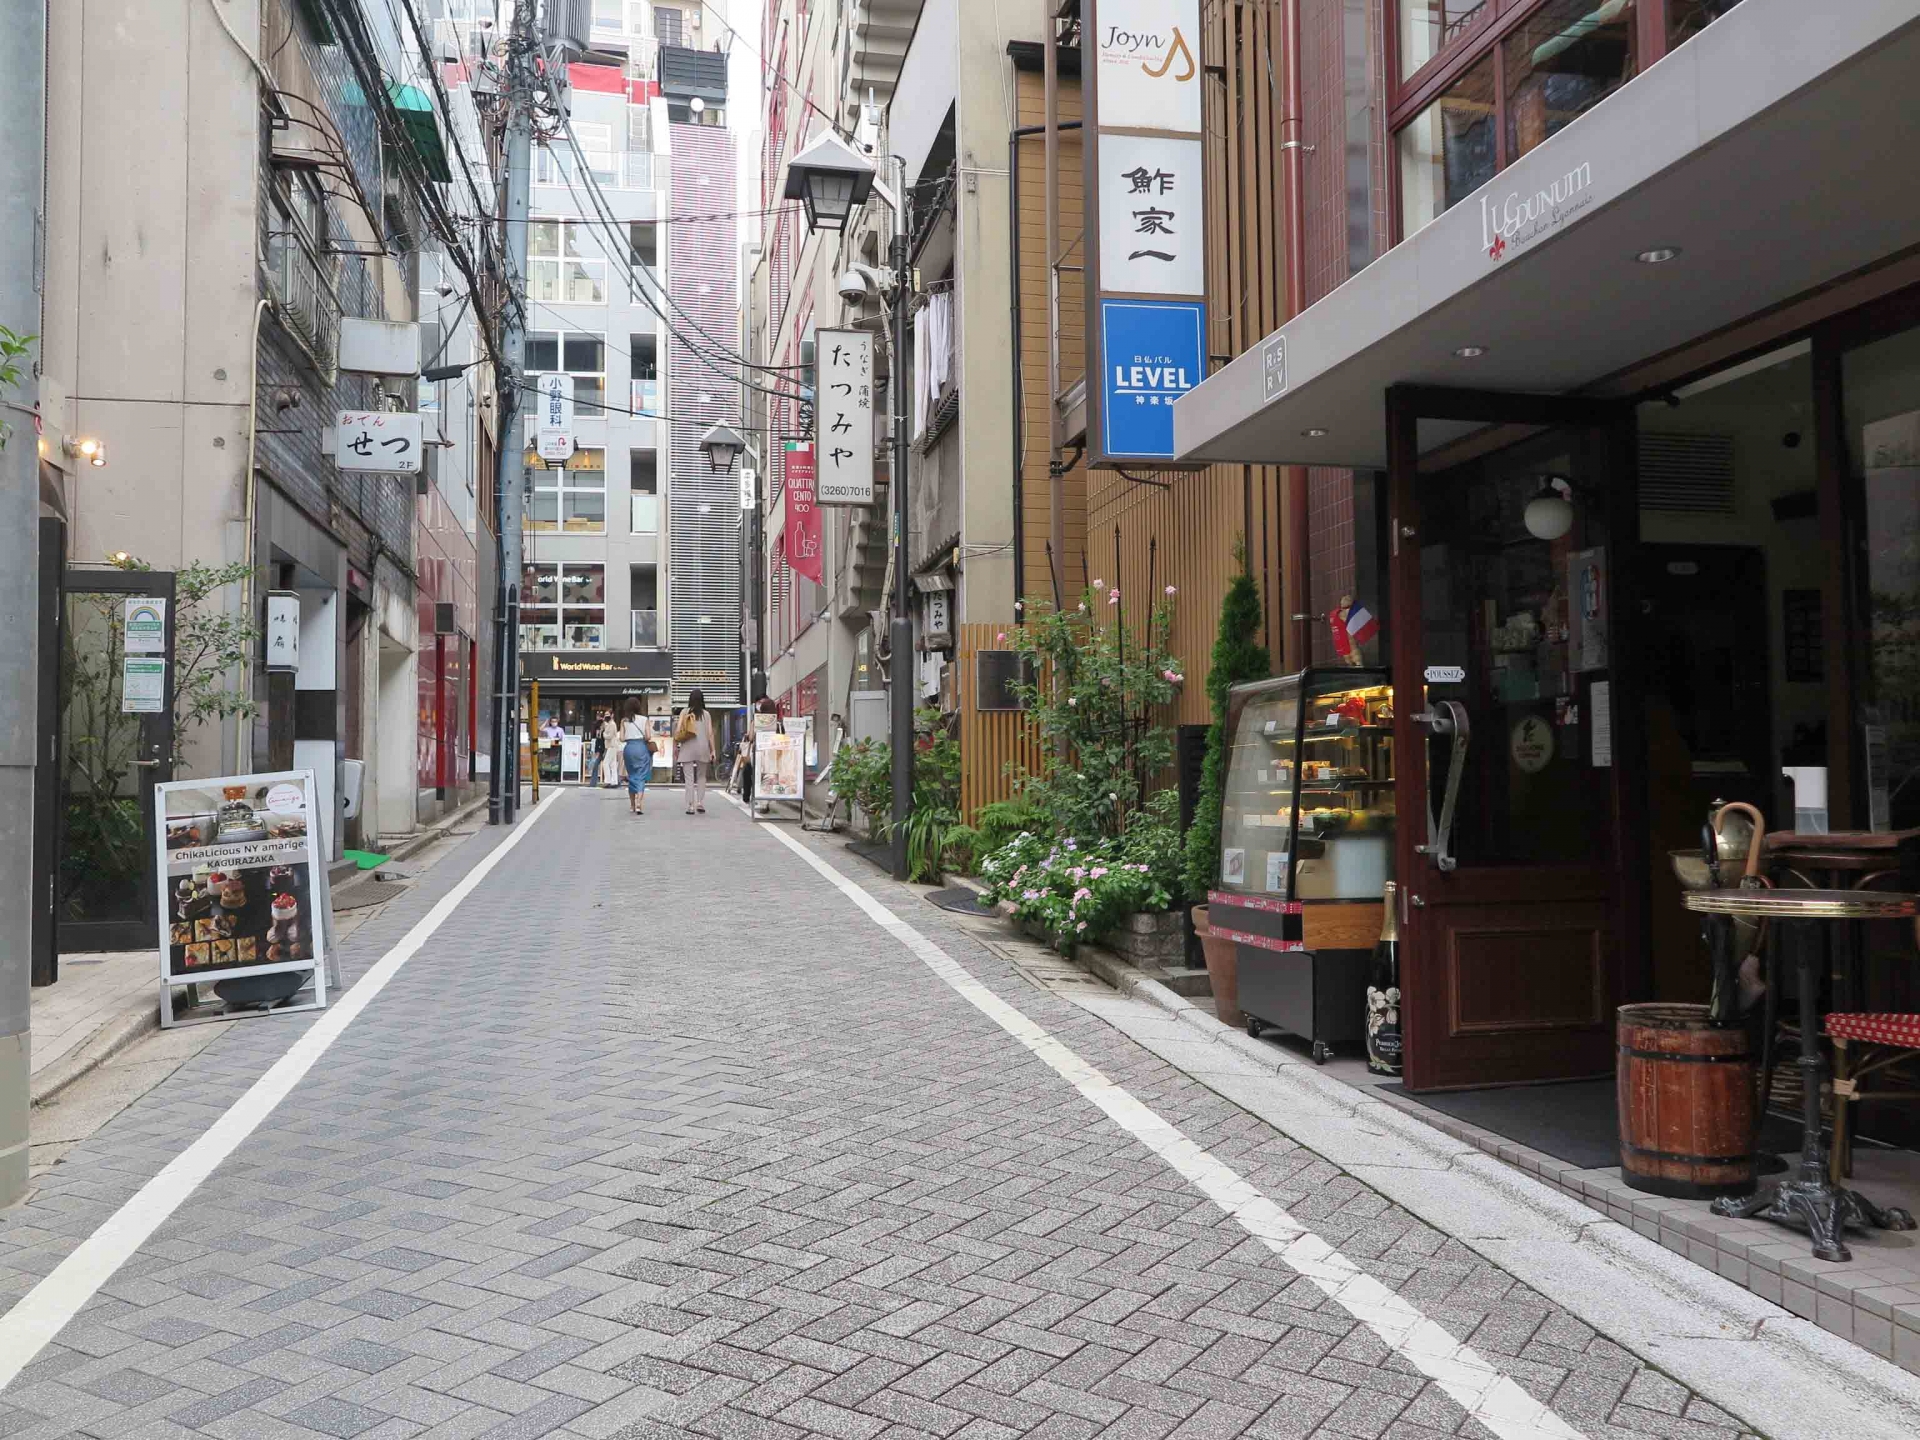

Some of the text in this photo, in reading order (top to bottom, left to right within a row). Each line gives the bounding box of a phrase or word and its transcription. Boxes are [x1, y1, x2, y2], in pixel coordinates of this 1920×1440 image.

[1101, 26, 1165, 53] Joyn
[1134, 355, 1173, 364] 日仏バル
[858, 340, 871, 409] うなぎ 蒲焼
[1115, 365, 1192, 389] LEVEL
[549, 377, 562, 427] 小野眼科
[829, 344, 854, 470] たつみや
[342, 414, 386, 428] おでん
[346, 431, 411, 457] せつ
[399, 460, 414, 470] 2F
[788, 477, 815, 492] QUATTR
[820, 485, 871, 498] (3260)7016
[793, 490, 812, 502] CENTO
[794, 503, 810, 513] 400
[933, 591, 944, 630] たつみや
[1430, 669, 1460, 679] POUSSEZ
[175, 840, 305, 861] ChikaLicious NY amarige
[207, 853, 275, 869] KAGURAZAKA
